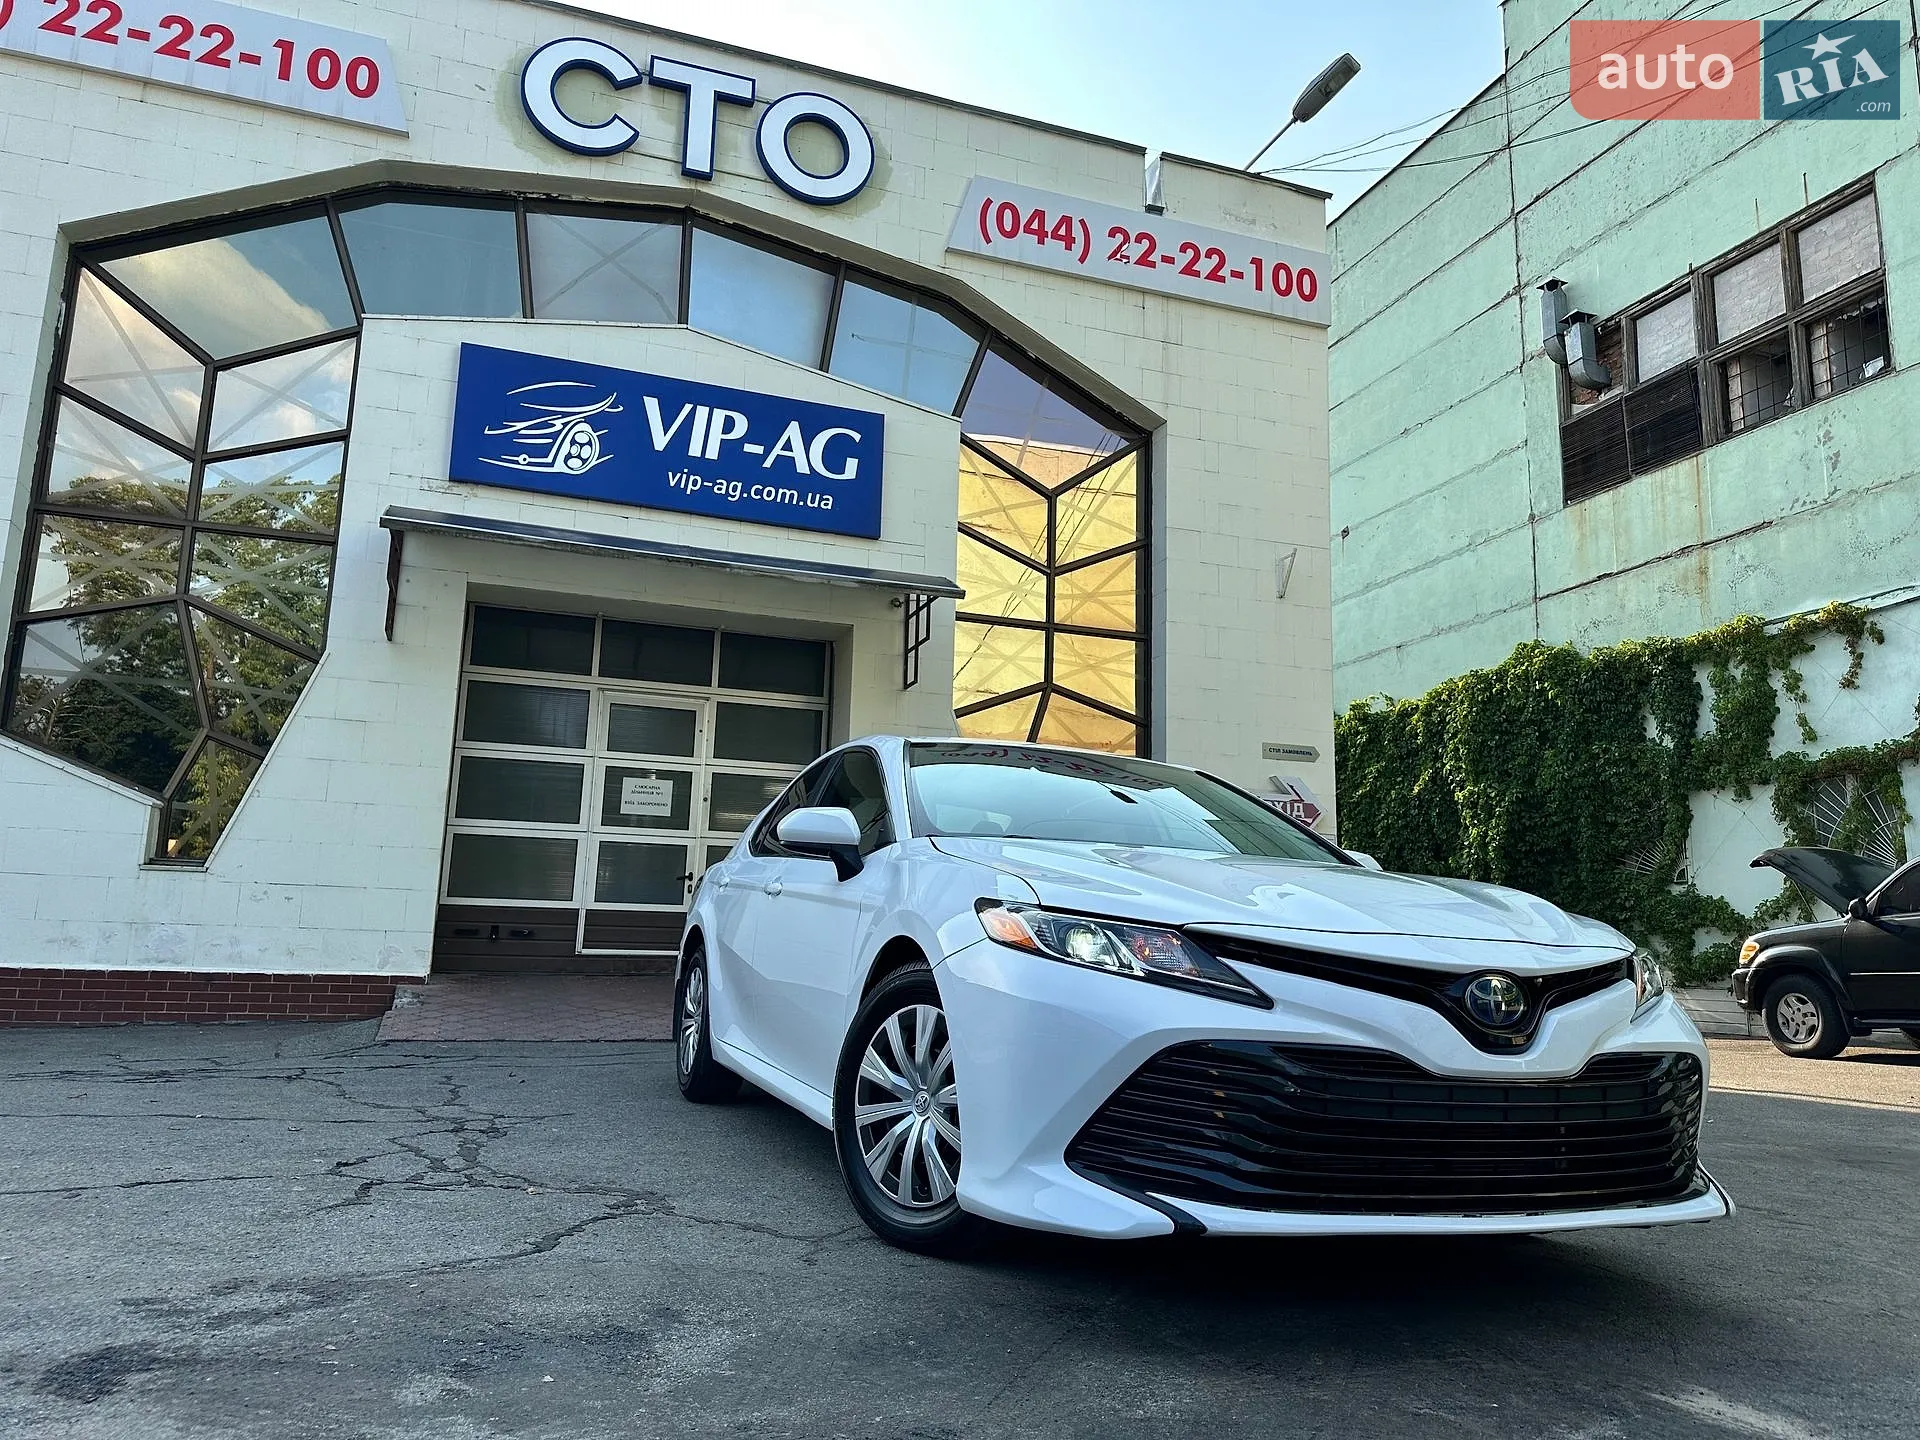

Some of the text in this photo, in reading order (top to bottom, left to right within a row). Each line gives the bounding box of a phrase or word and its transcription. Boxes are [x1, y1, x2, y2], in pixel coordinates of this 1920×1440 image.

[37, 0, 381, 98] 22-22-100
[520, 36, 875, 206] СТО
[978, 197, 1319, 303] (044) 22-22-100
[642, 395, 862, 480] VIP-AG
[667, 468, 834, 511] vip-ag.com.ua
